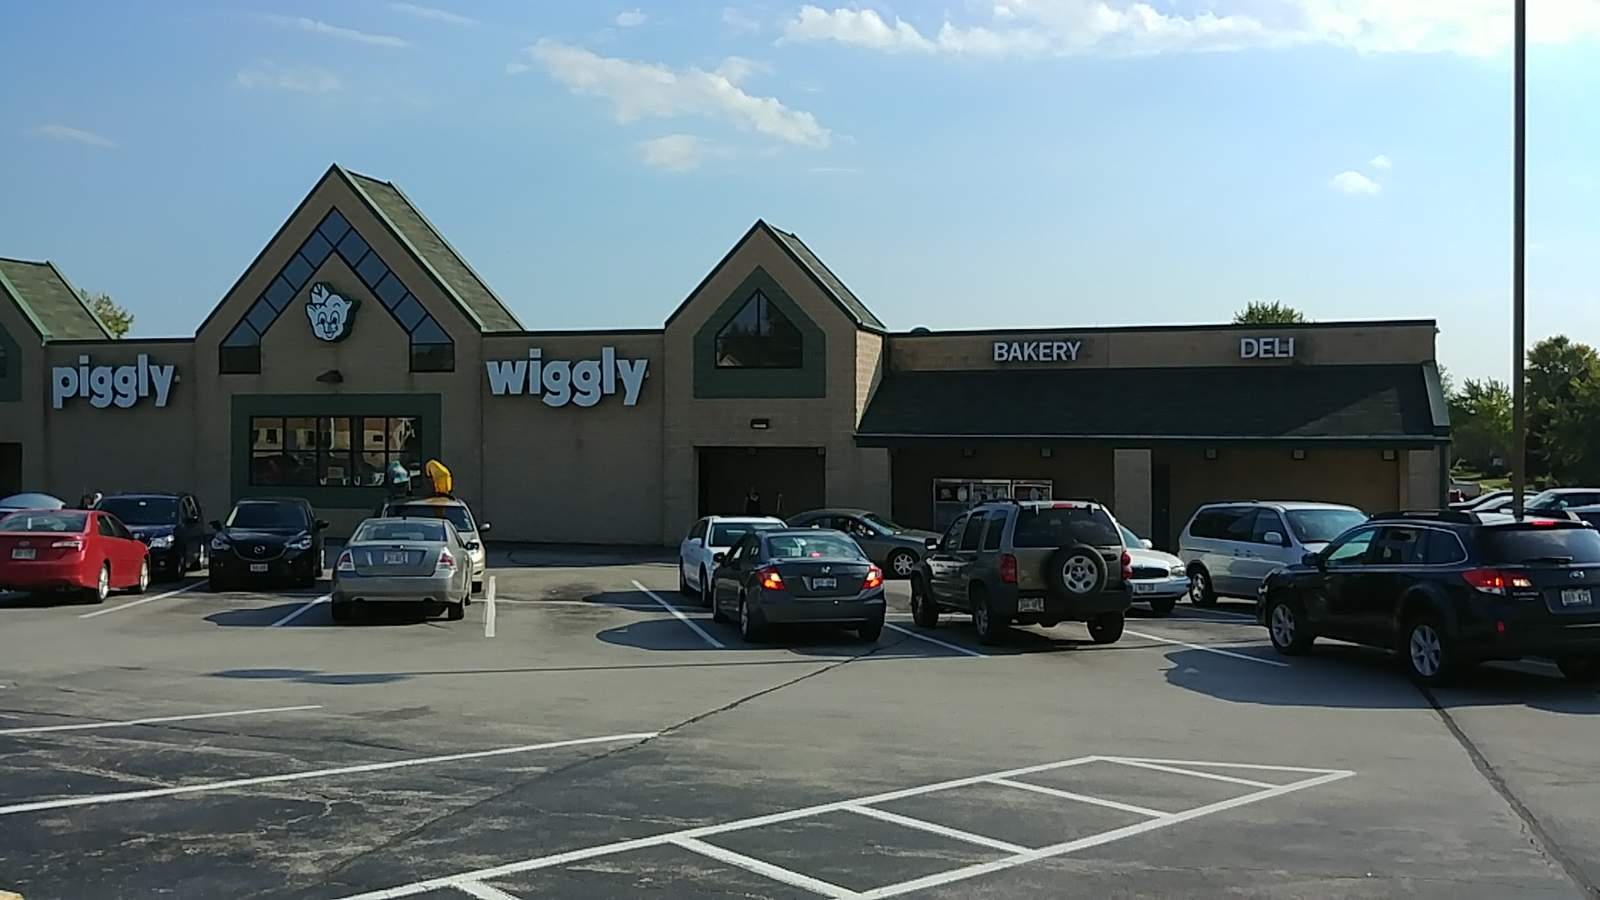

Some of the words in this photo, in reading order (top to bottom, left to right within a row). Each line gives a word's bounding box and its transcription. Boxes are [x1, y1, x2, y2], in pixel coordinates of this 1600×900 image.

[993, 341, 1081, 362] BAKERY
[1240, 337, 1295, 359] DELI
[52, 353, 174, 409] piggly
[486, 347, 649, 407] wiggly
